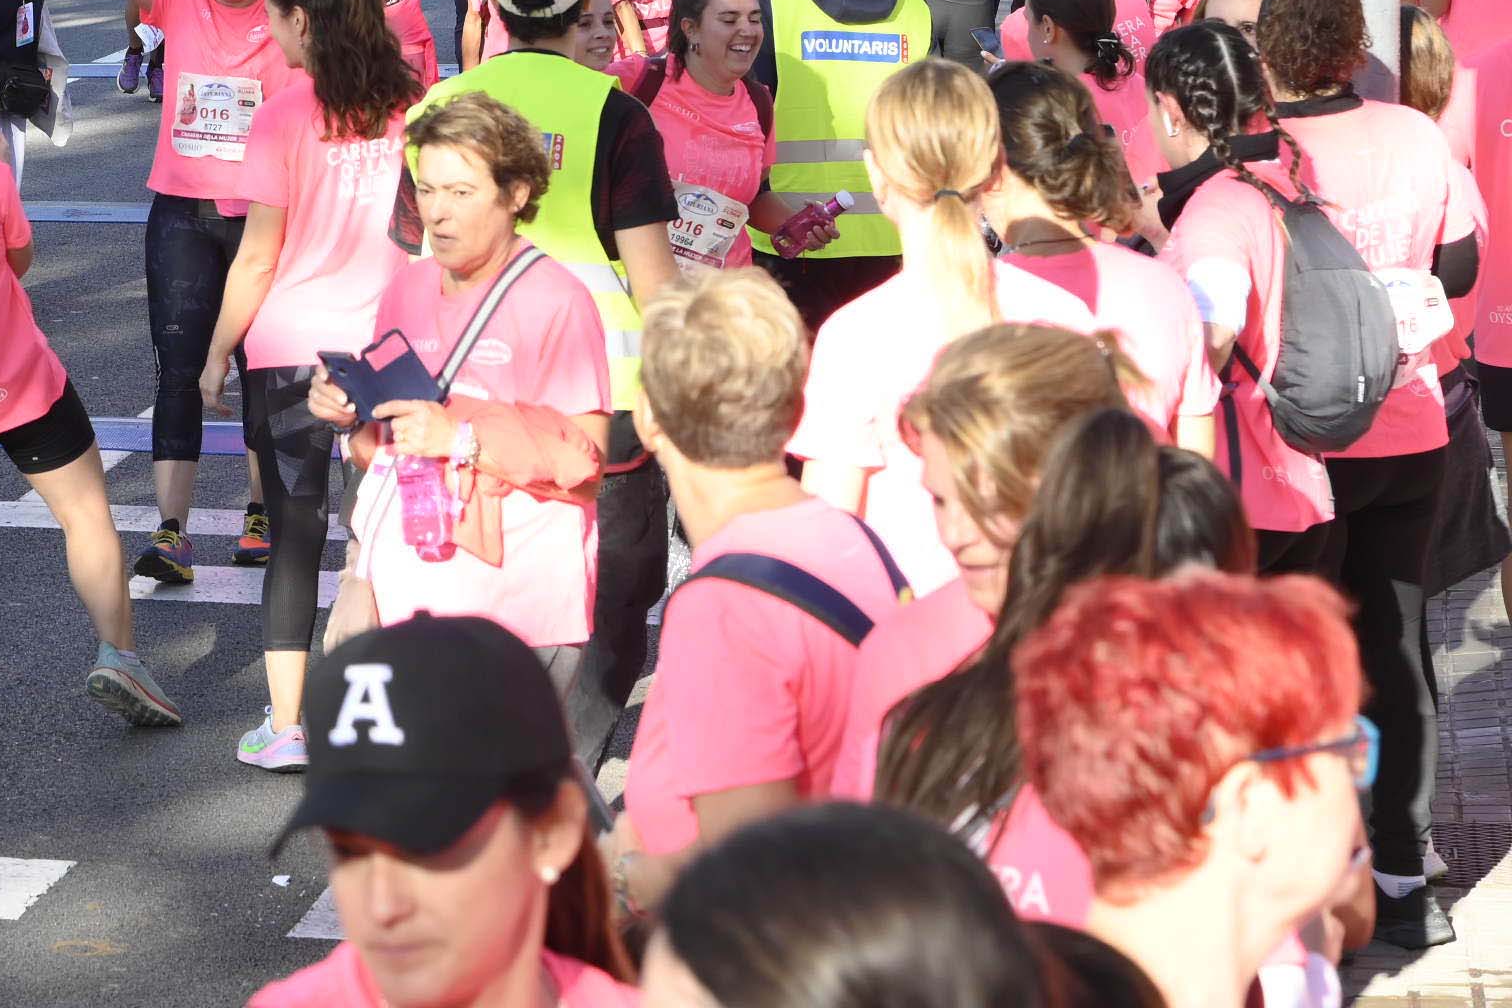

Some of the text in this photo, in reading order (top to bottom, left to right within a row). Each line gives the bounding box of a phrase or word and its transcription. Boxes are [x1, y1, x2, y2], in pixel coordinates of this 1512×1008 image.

[804, 38, 899, 56] VOLUNTARIS
[199, 107, 230, 121] 016
[327, 137, 403, 166] CARRERA
[672, 217, 704, 237] 016
[328, 663, 405, 746] A
